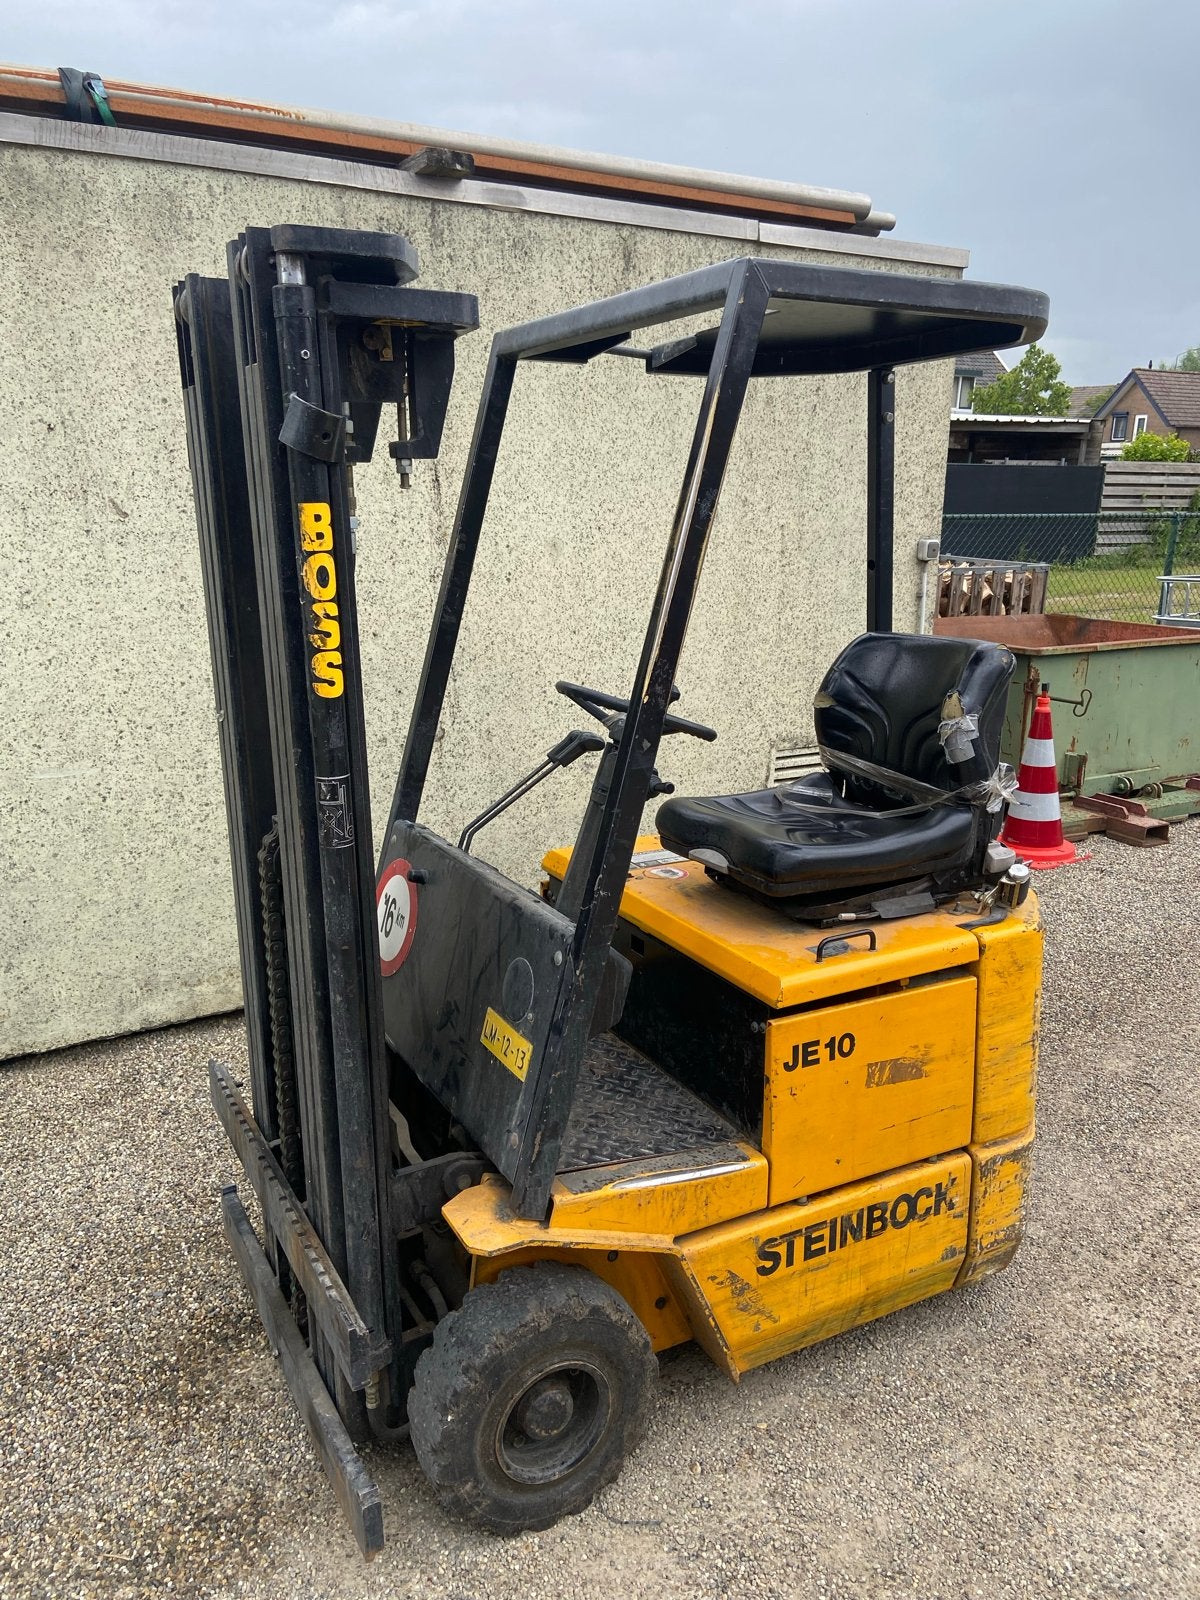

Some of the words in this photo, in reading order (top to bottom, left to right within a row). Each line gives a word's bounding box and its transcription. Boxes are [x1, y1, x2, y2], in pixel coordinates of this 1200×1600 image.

[298, 502, 344, 699] BOSS
[381, 892, 396, 938] 16
[396, 907, 405, 929] km
[484, 1019, 526, 1070] LM-12-13
[756, 1175, 958, 1277] STEINBOCK
